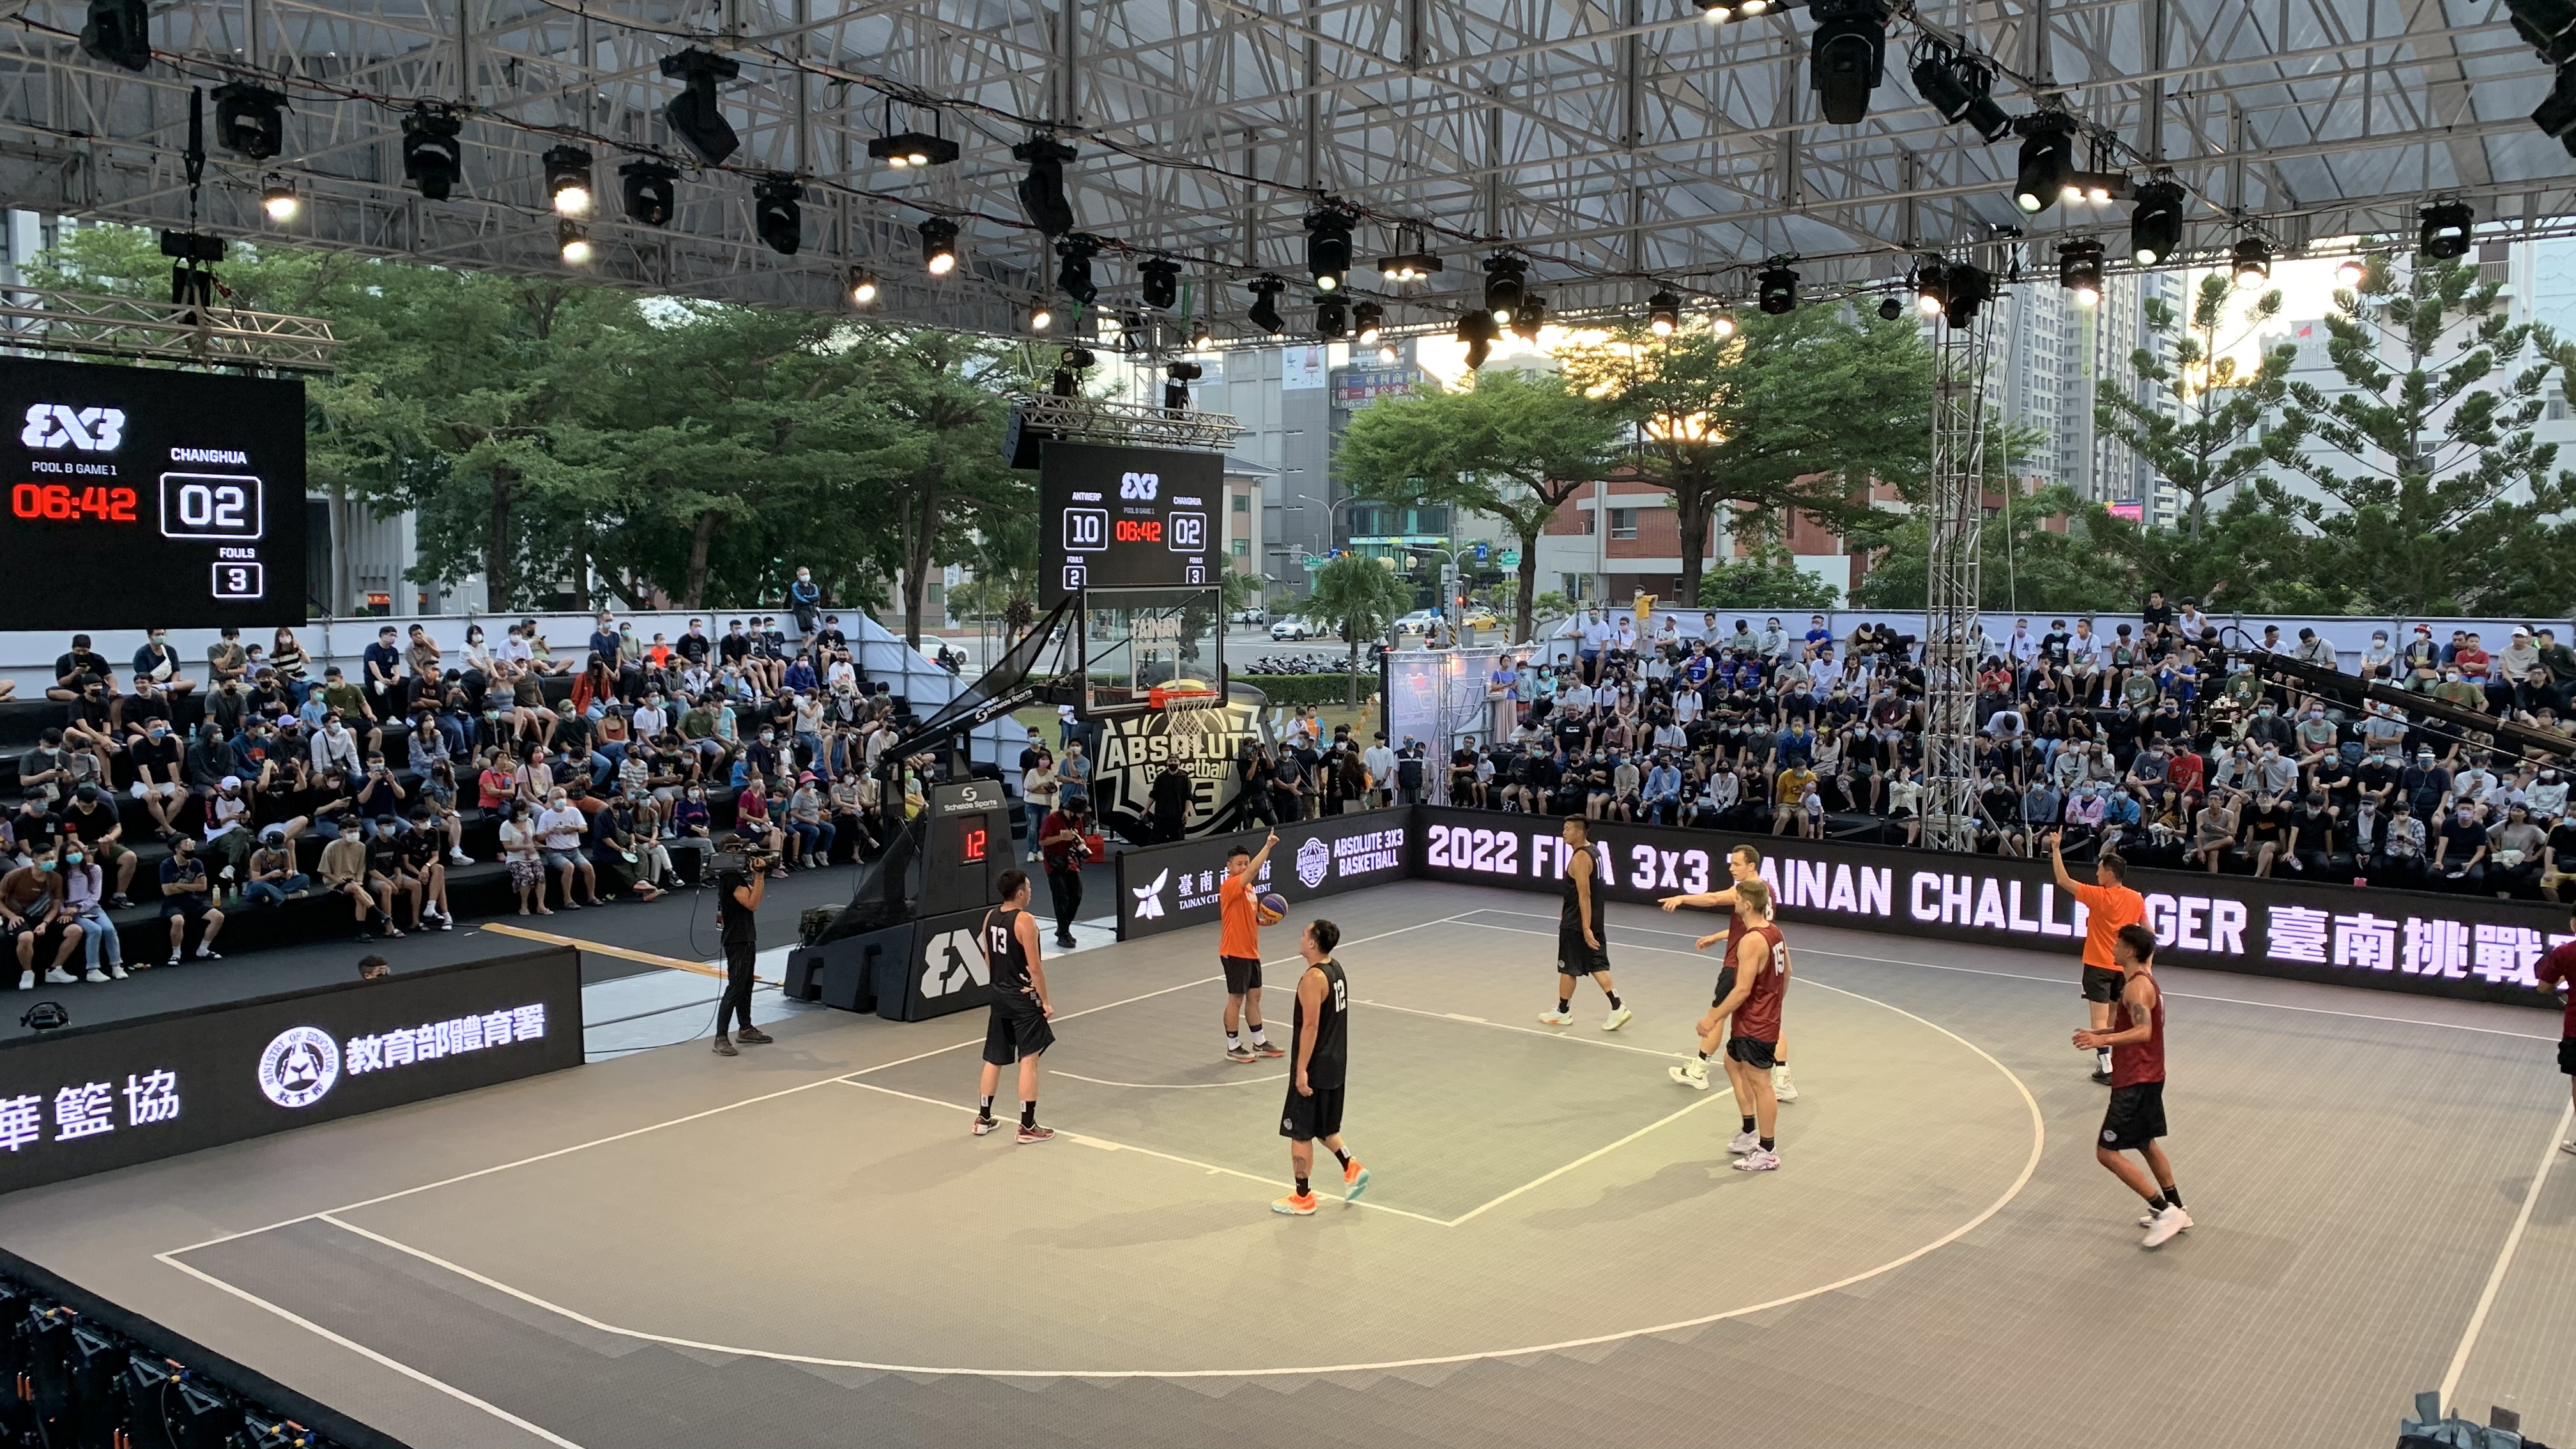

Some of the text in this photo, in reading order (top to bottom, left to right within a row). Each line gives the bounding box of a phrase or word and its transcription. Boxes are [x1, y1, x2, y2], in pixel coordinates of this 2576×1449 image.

[171, 448, 247, 464] CHANGHUA
[32, 462, 117, 475] POOL B GAME 1
[13, 484, 136, 521] 06:42
[179, 484, 245, 526] 02
[1072, 491, 1101, 502] ANTWERP
[1173, 496, 1202, 506] CHANGHUA
[1073, 515, 1099, 542] 10
[1116, 520, 1161, 542] 06:42
[1176, 519, 1200, 544] 02
[220, 548, 255, 558] FOULS
[229, 568, 247, 592] 3
[1070, 569, 1080, 585] 2
[1192, 569, 1200, 584] 3
[1130, 618, 1181, 639] TAINAN
[1011, 689, 1032, 702] Sports
[1145, 759, 1228, 783] Baketball
[974, 799, 998, 809] Sports
[966, 829, 986, 857] 12
[1333, 828, 1404, 858] ABSOLUTE 3X3
[1298, 852, 1328, 868] ABSOLUTE
[1339, 848, 1399, 877] BASKETBALL
[1428, 824, 1517, 875] 2022
[1726, 853, 1892, 916] AINAN
[1178, 859, 1271, 897] 臺南市府
[1179, 893, 1221, 910] TAINAN CIT
[990, 925, 1008, 954] 13
[2267, 906, 2576, 990] 臺南挑戰
[1772, 940, 1785, 977] 15
[1333, 979, 1346, 1013] 12
[346, 1003, 546, 1076] 教育部體育署
[263, 1032, 334, 1085] MINISTRY OF EDUCATION
